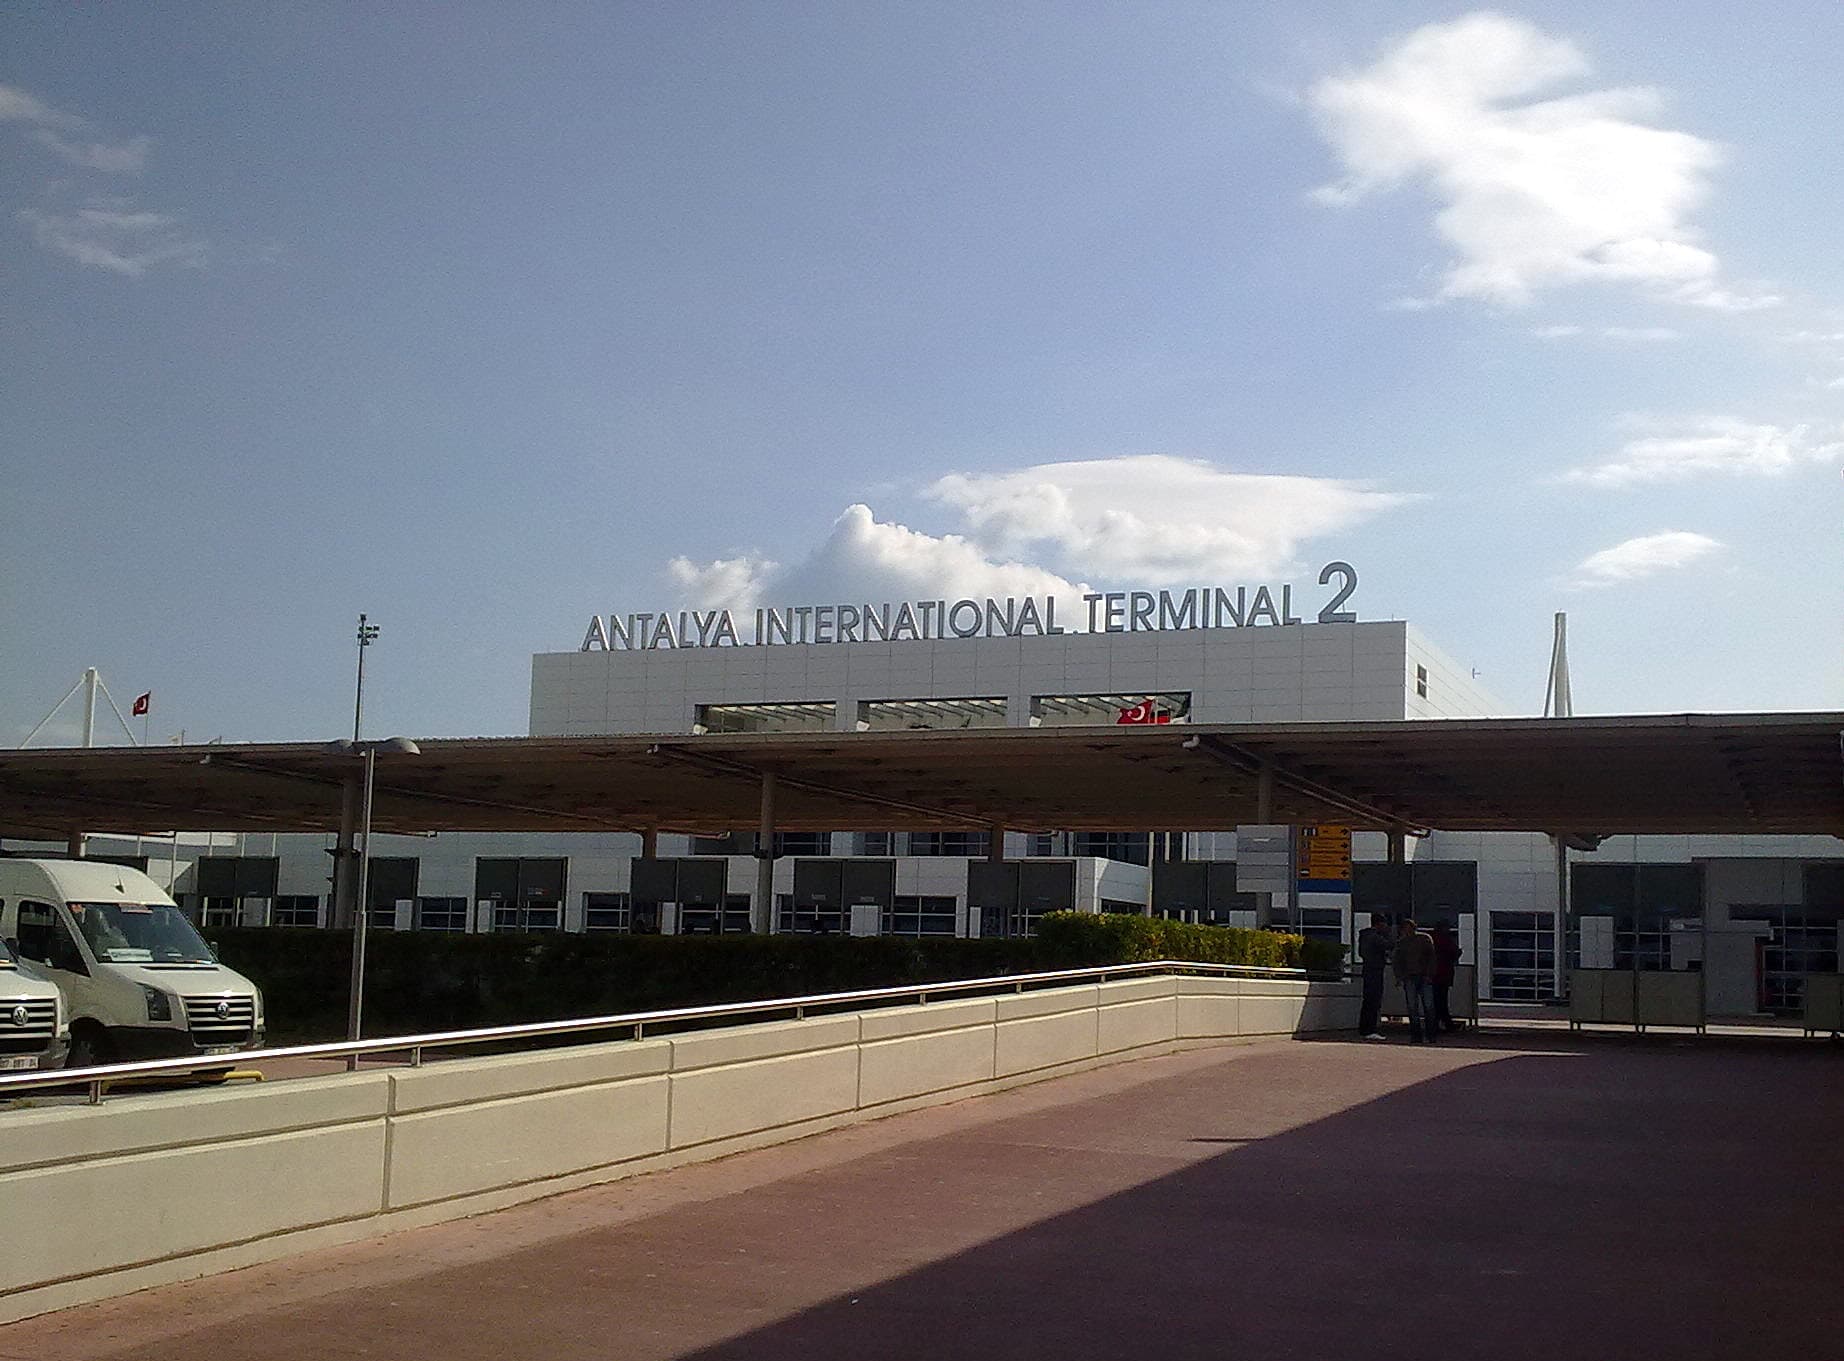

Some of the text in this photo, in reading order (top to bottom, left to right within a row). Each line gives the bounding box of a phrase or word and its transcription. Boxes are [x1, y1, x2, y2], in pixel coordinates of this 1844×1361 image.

[580, 561, 1358, 652] ANTALYA INTERNATIONAL TERMINAL 2
